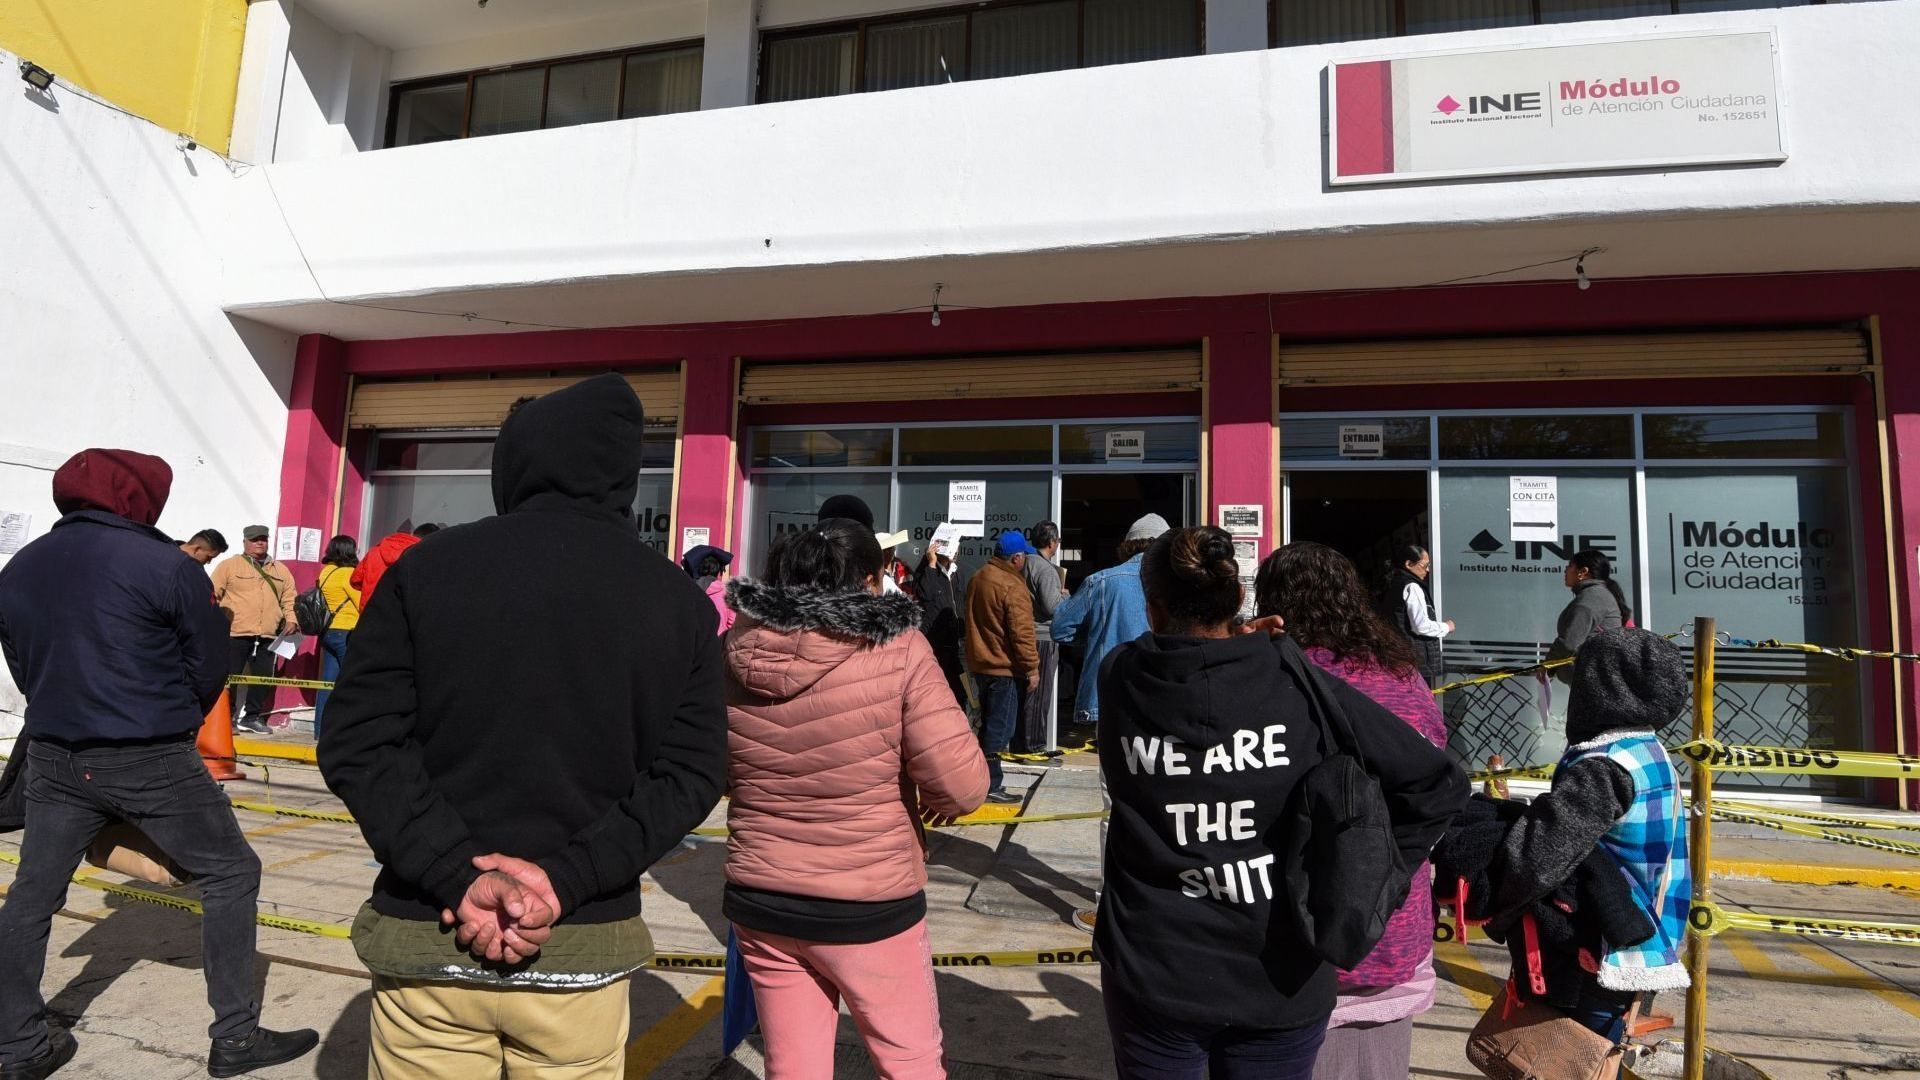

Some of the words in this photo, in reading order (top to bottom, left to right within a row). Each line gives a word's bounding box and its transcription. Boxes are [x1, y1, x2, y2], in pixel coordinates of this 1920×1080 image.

[1560, 76, 1681, 101] Módulo
[1469, 91, 1541, 115] INE
[1562, 103, 1583, 116] de
[1589, 98, 1664, 114] Atención
[1671, 93, 1767, 110] Ciudadana
[1430, 117, 1465, 125] Instituto
[1467, 115, 1503, 123] Nacional
[1698, 113, 1719, 122] No.
[1112, 438, 1139, 448] SALIDA
[1343, 433, 1380, 443] ENTRADA
[1512, 492, 1533, 500] CON
[1534, 492, 1555, 500] CITA
[1682, 521, 1834, 549] Módulo
[1460, 563, 1507, 573] Instituto
[1684, 551, 1715, 569] de
[1120, 735, 1191, 776] WE
[1203, 724, 1290, 774] ARE
[1165, 800, 1257, 846] THE
[1178, 854, 1275, 904] SHIT
